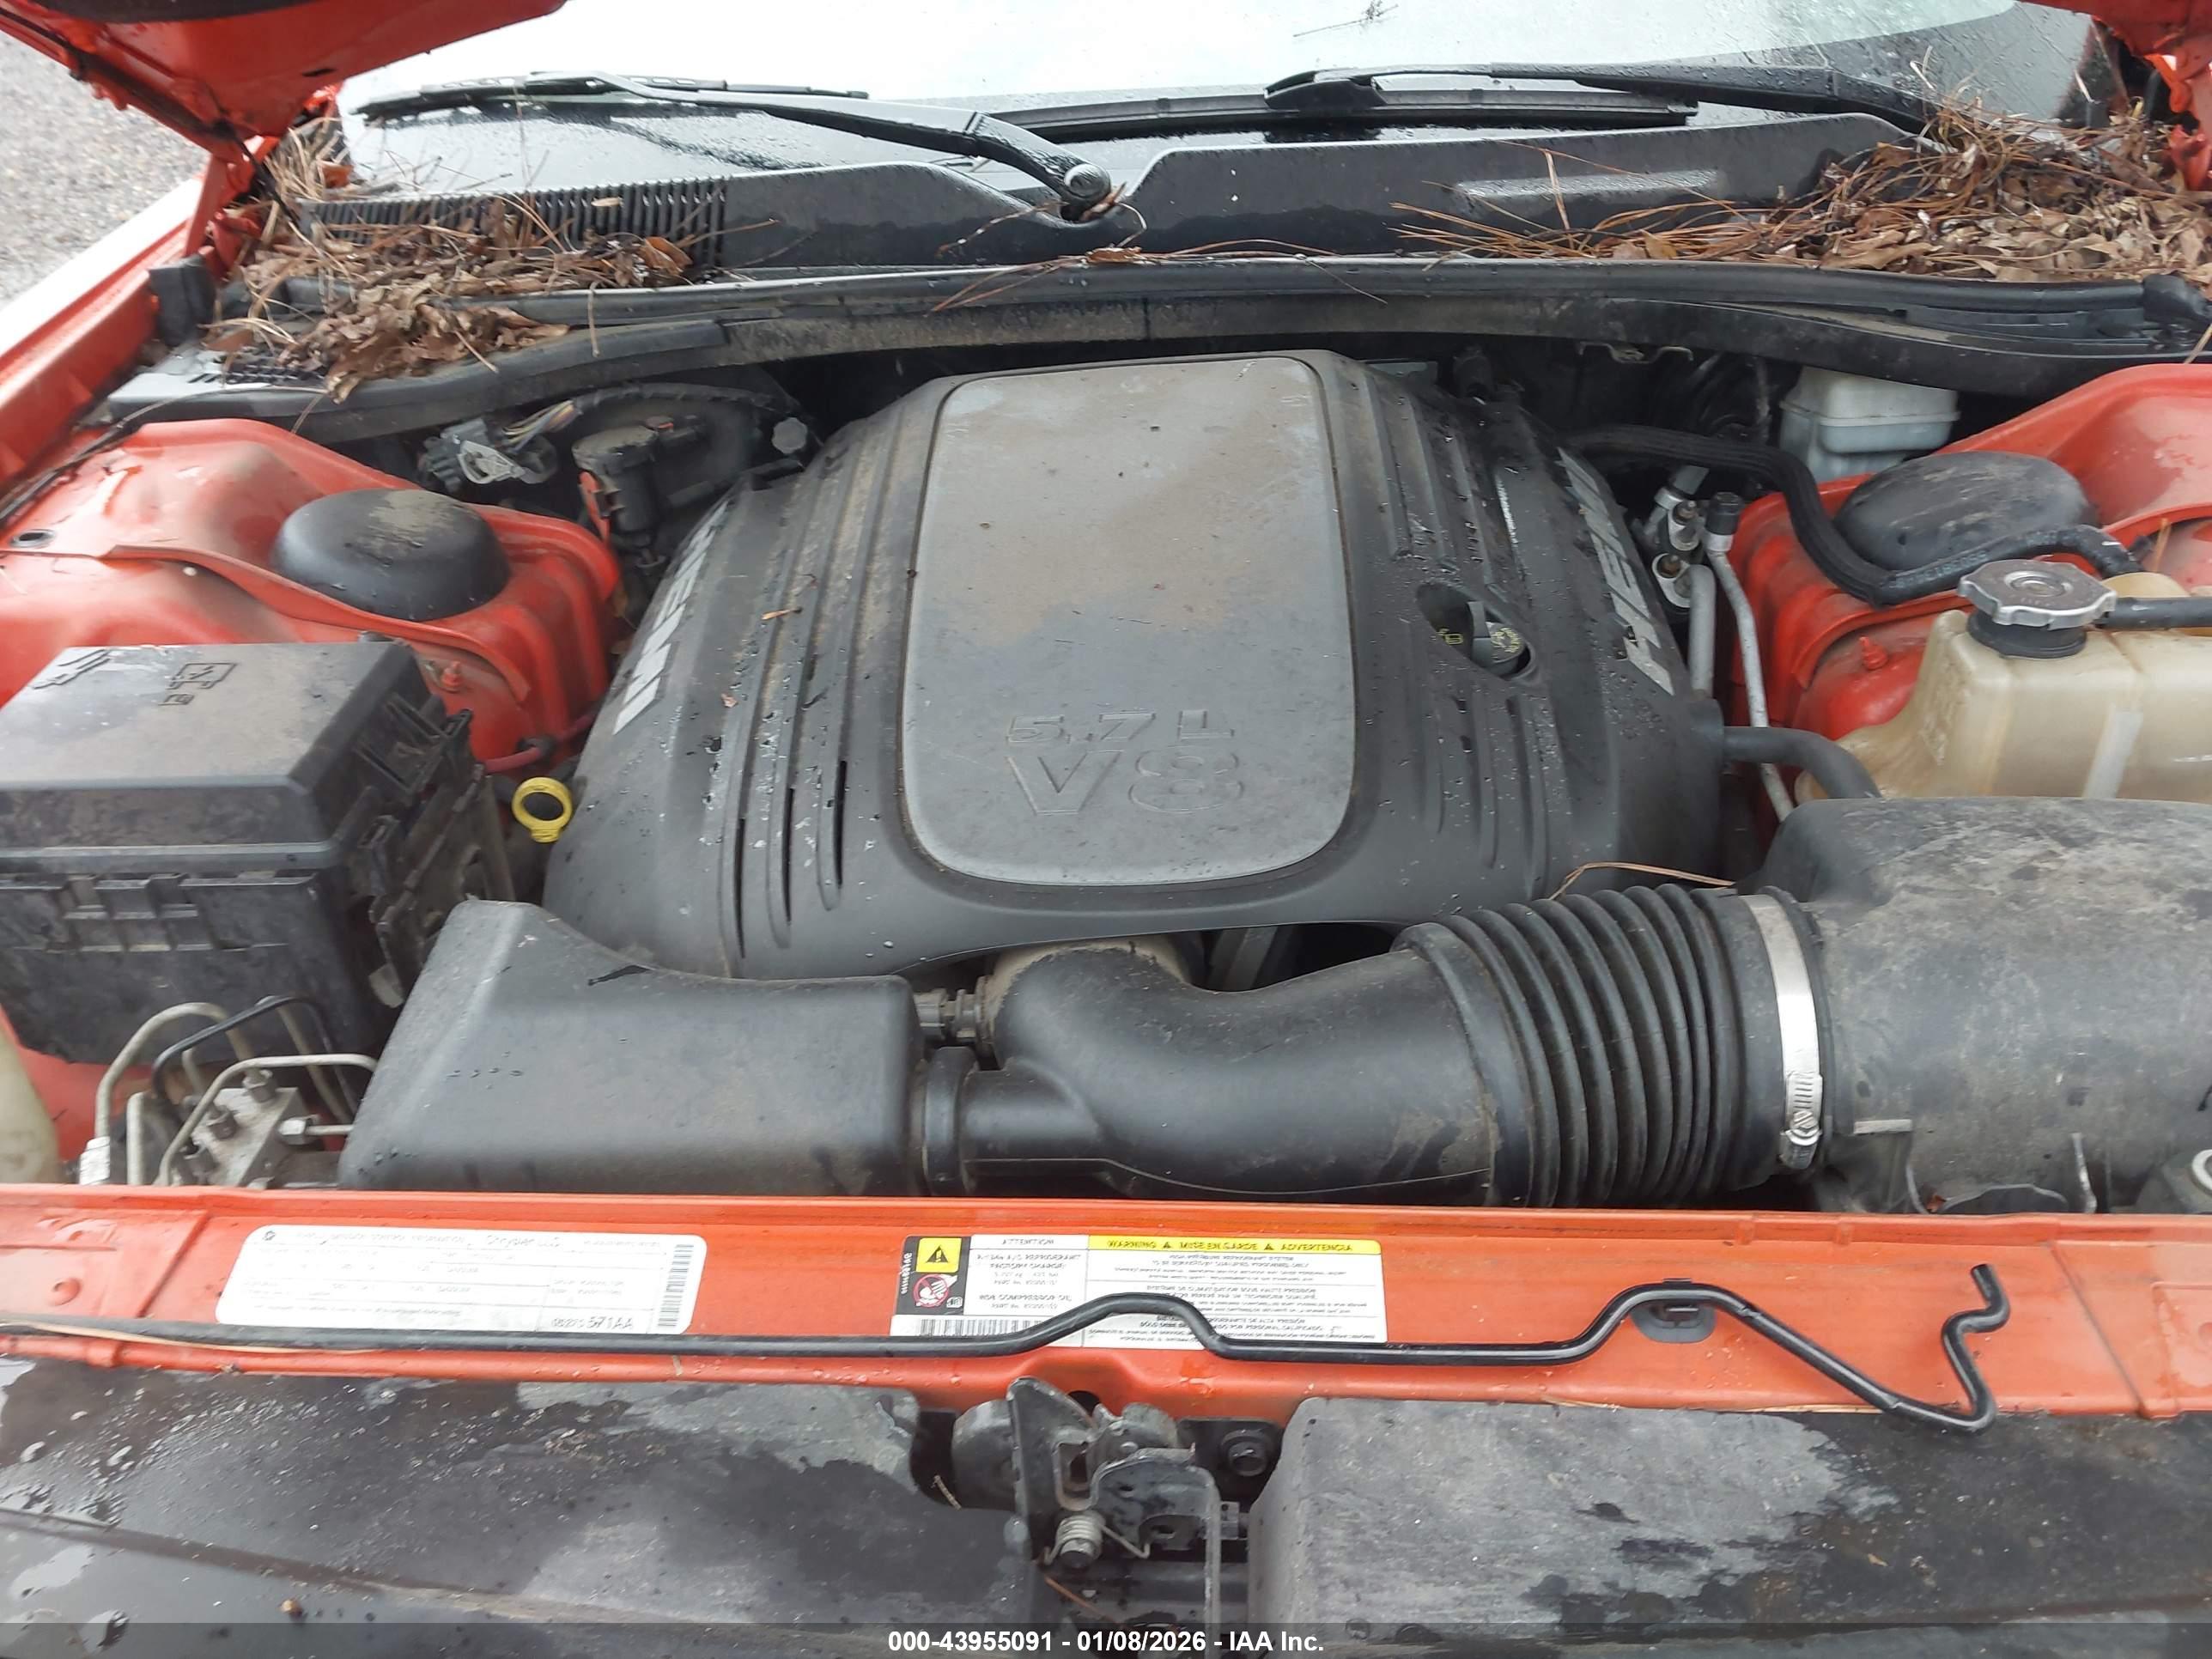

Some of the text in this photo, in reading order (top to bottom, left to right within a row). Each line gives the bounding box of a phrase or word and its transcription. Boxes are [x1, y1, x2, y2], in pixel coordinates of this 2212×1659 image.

[1004, 749, 1244, 816] V8
[1107, 1240, 1157, 1249] WARNING
[1179, 1241, 1204, 1250] MISE
[1223, 1243, 1258, 1251] GARDE
[1280, 1243, 1353, 1252] ADVERTENCIA
